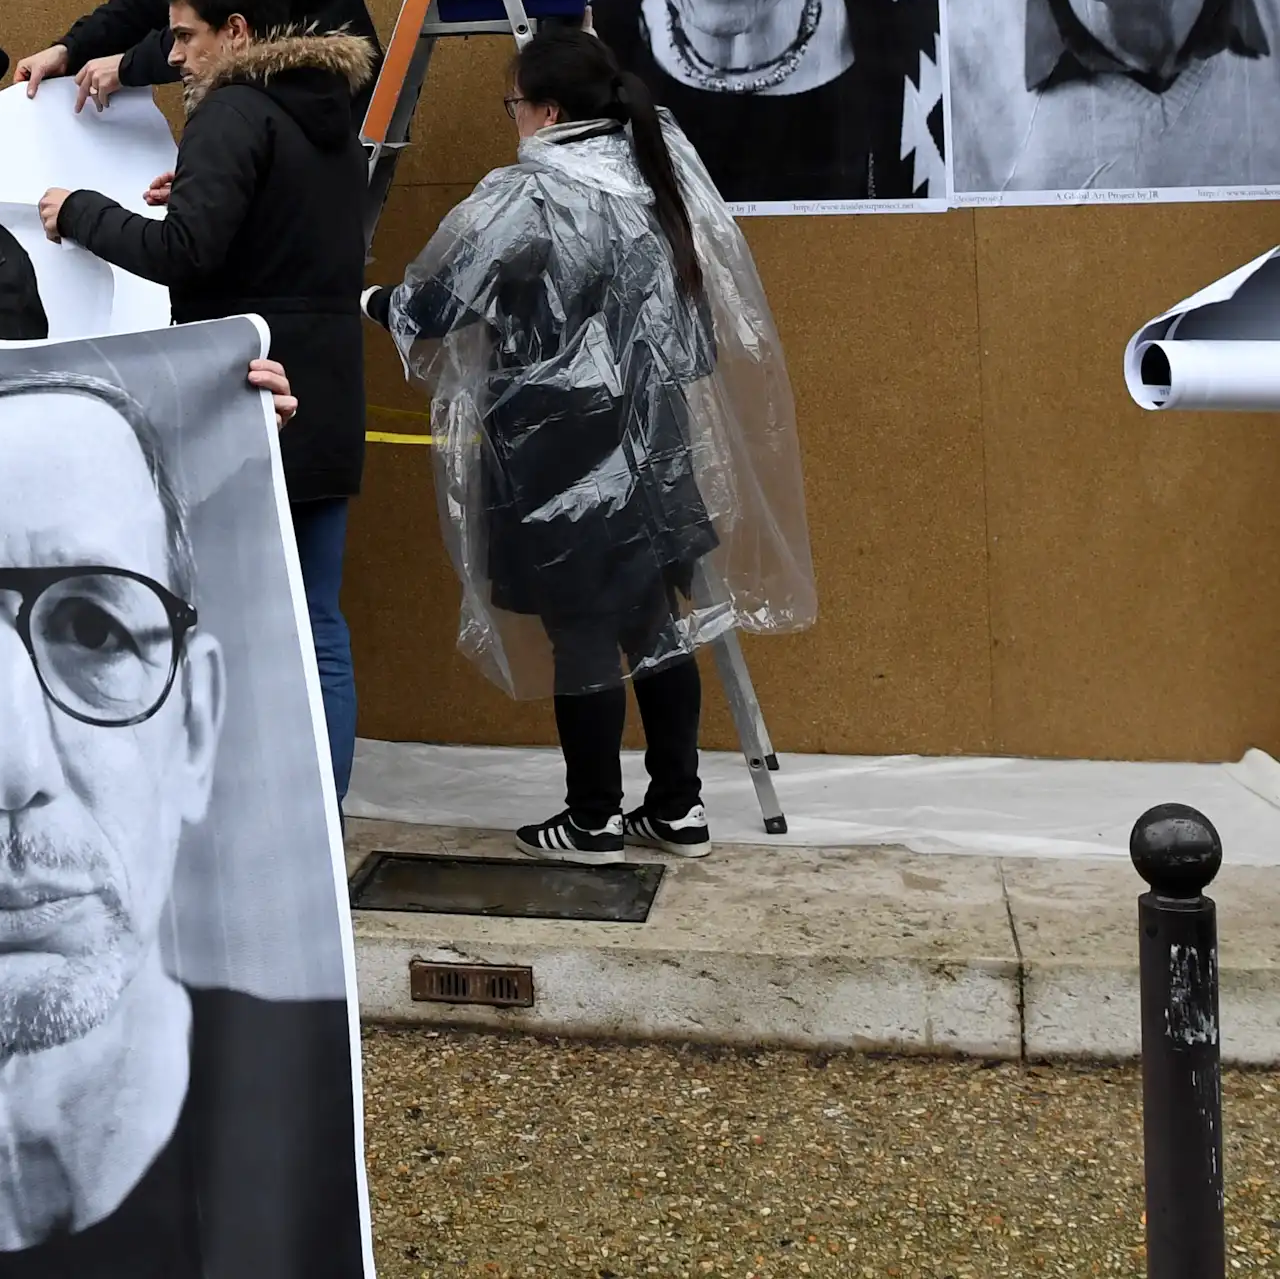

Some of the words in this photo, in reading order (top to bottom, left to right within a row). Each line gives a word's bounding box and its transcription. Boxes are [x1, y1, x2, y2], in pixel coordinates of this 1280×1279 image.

[1092, 191, 1105, 199] Art
[1108, 190, 1134, 200] Project
[1148, 189, 1159, 199] JR
[747, 204, 756, 213] JR
